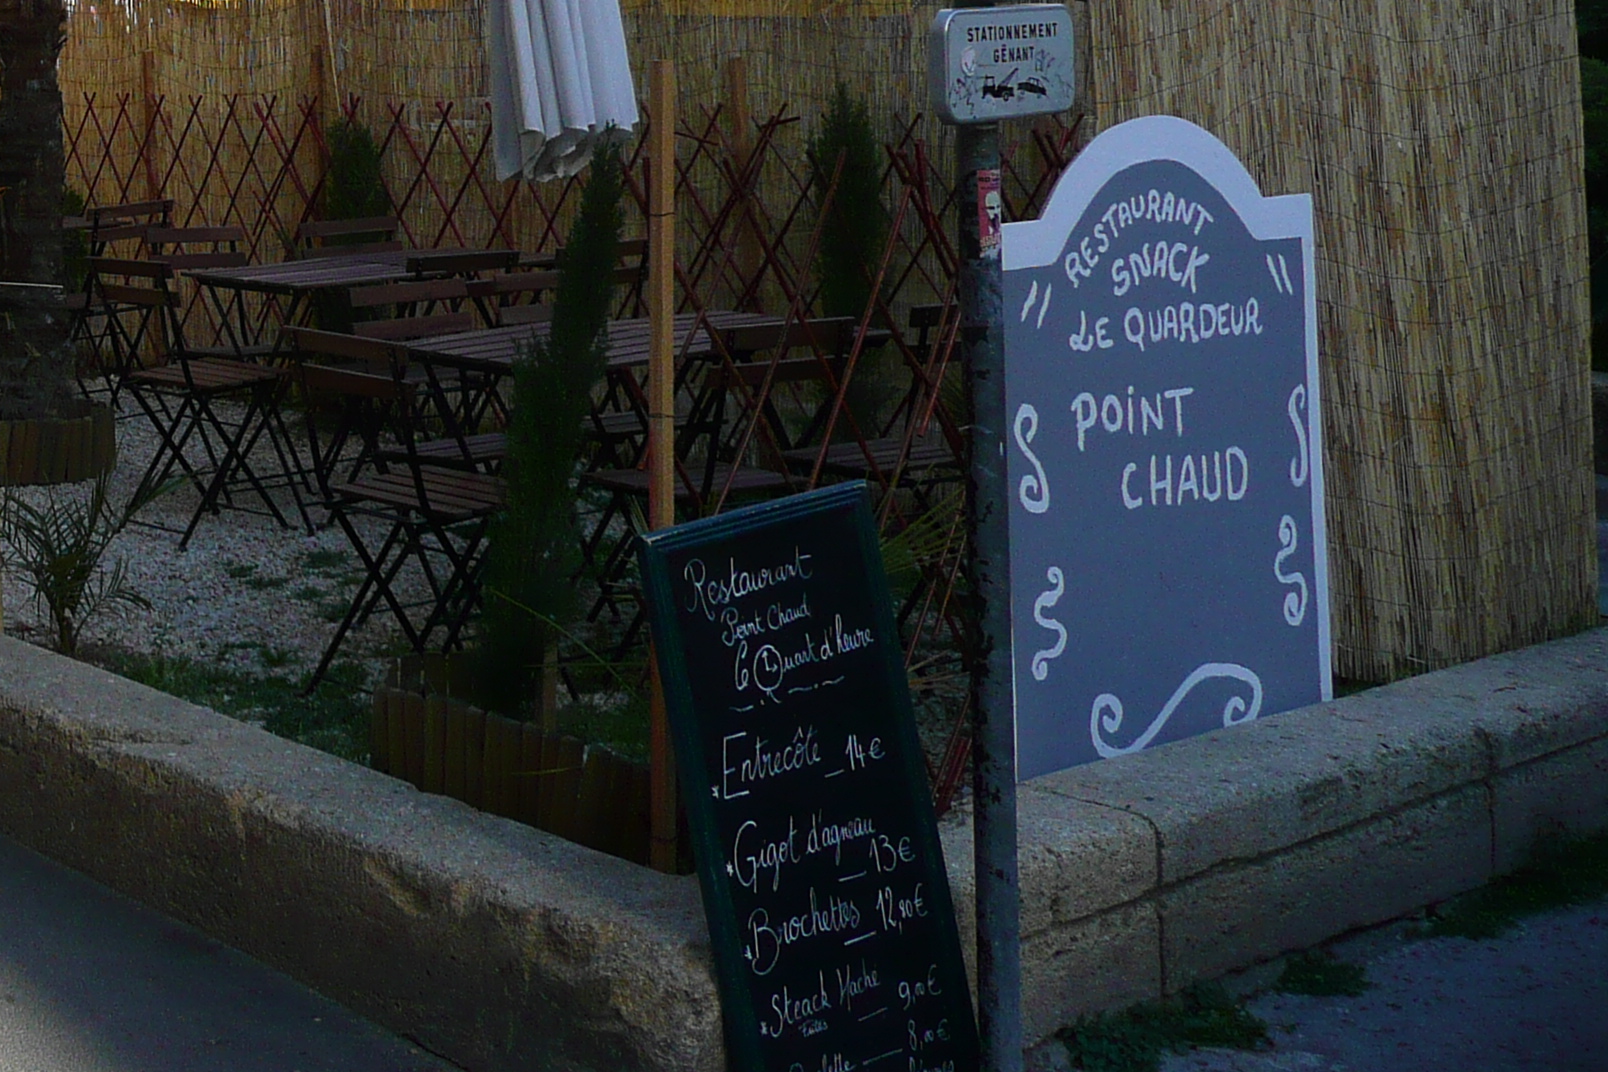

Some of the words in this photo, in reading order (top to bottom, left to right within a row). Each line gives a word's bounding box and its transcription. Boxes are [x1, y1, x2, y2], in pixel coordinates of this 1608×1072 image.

[967, 22, 1058, 42] STATIONNEMENT
[993, 43, 1035, 63] GÊNANT
[1065, 189, 1214, 288] RESTAURANT
[1111, 240, 1210, 296] SNACK
[1069, 310, 1114, 352] LE
[1124, 297, 1263, 352] QUARDEUR
[1070, 385, 1194, 452] POINT
[1121, 446, 1248, 510] CHAUD
[684, 545, 812, 621] Restaurant
[720, 607, 766, 647] Point
[767, 592, 812, 630] Chaud
[753, 632, 819, 704] Quart
[820, 613, 874, 660] d'heure
[723, 725, 822, 800] Entrecôte
[845, 734, 886, 771] 14€
[734, 815, 800, 894] Gigot
[806, 808, 876, 866] d'agneau
[869, 834, 916, 872] 13€
[748, 886, 861, 976] Brochettes
